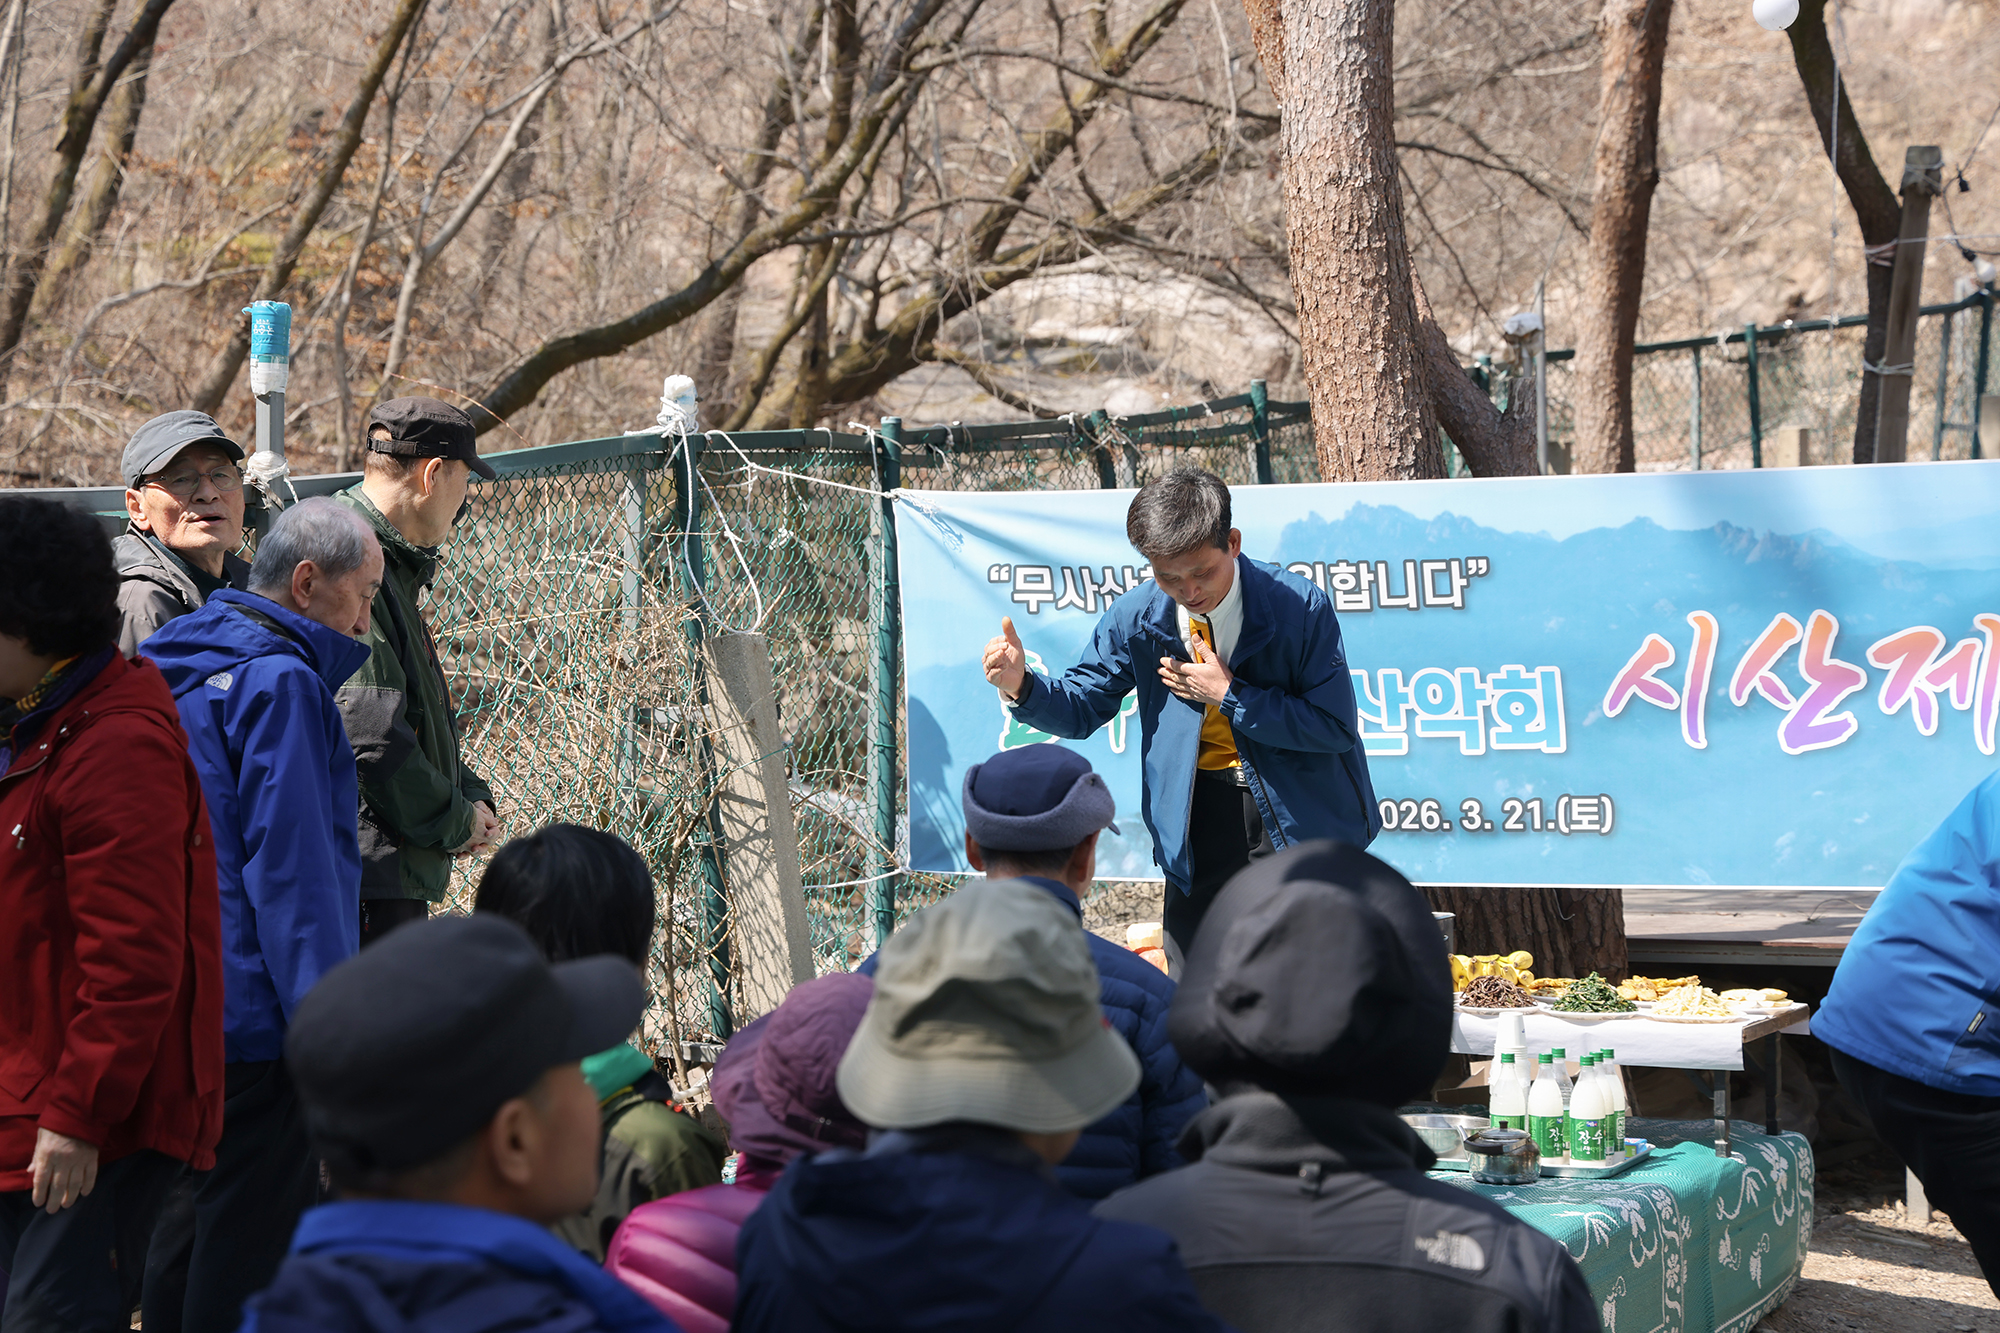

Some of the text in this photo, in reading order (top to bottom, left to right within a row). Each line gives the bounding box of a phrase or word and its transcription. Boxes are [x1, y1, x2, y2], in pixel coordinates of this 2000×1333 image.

[988, 563, 1154, 614] “무사산
[1603, 609, 2000, 755] 시산제
[1378, 793, 1615, 836] 026. 3. 21.(토)
[1578, 1130, 1603, 1145] 장수
